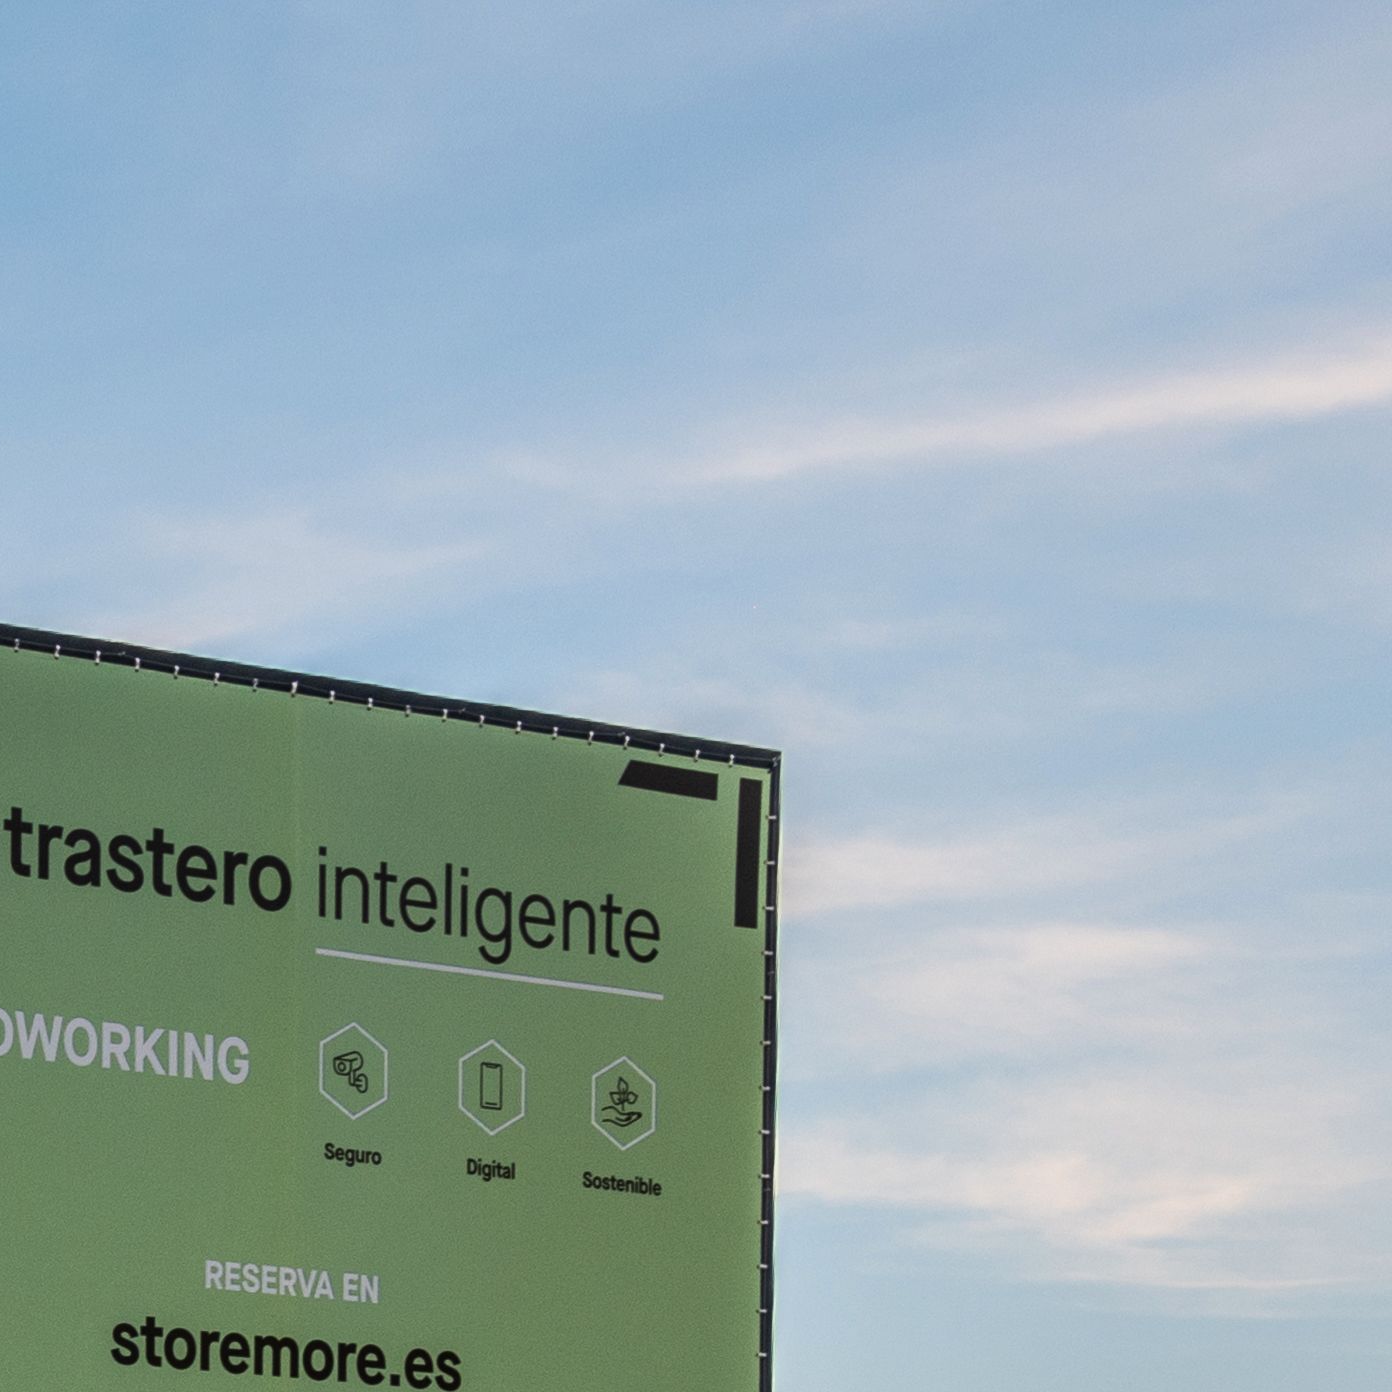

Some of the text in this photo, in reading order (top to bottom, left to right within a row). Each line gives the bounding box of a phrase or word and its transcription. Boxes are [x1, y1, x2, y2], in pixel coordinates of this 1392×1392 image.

[3, 806, 292, 912] trastero
[317, 846, 661, 963] inteligente
[324, 1142, 382, 1168] Seguro
[466, 1157, 516, 1183] Digital
[582, 1170, 663, 1197] Sostenible
[204, 1259, 379, 1304] RESERVA EN
[110, 1316, 462, 1392] storemore.es
